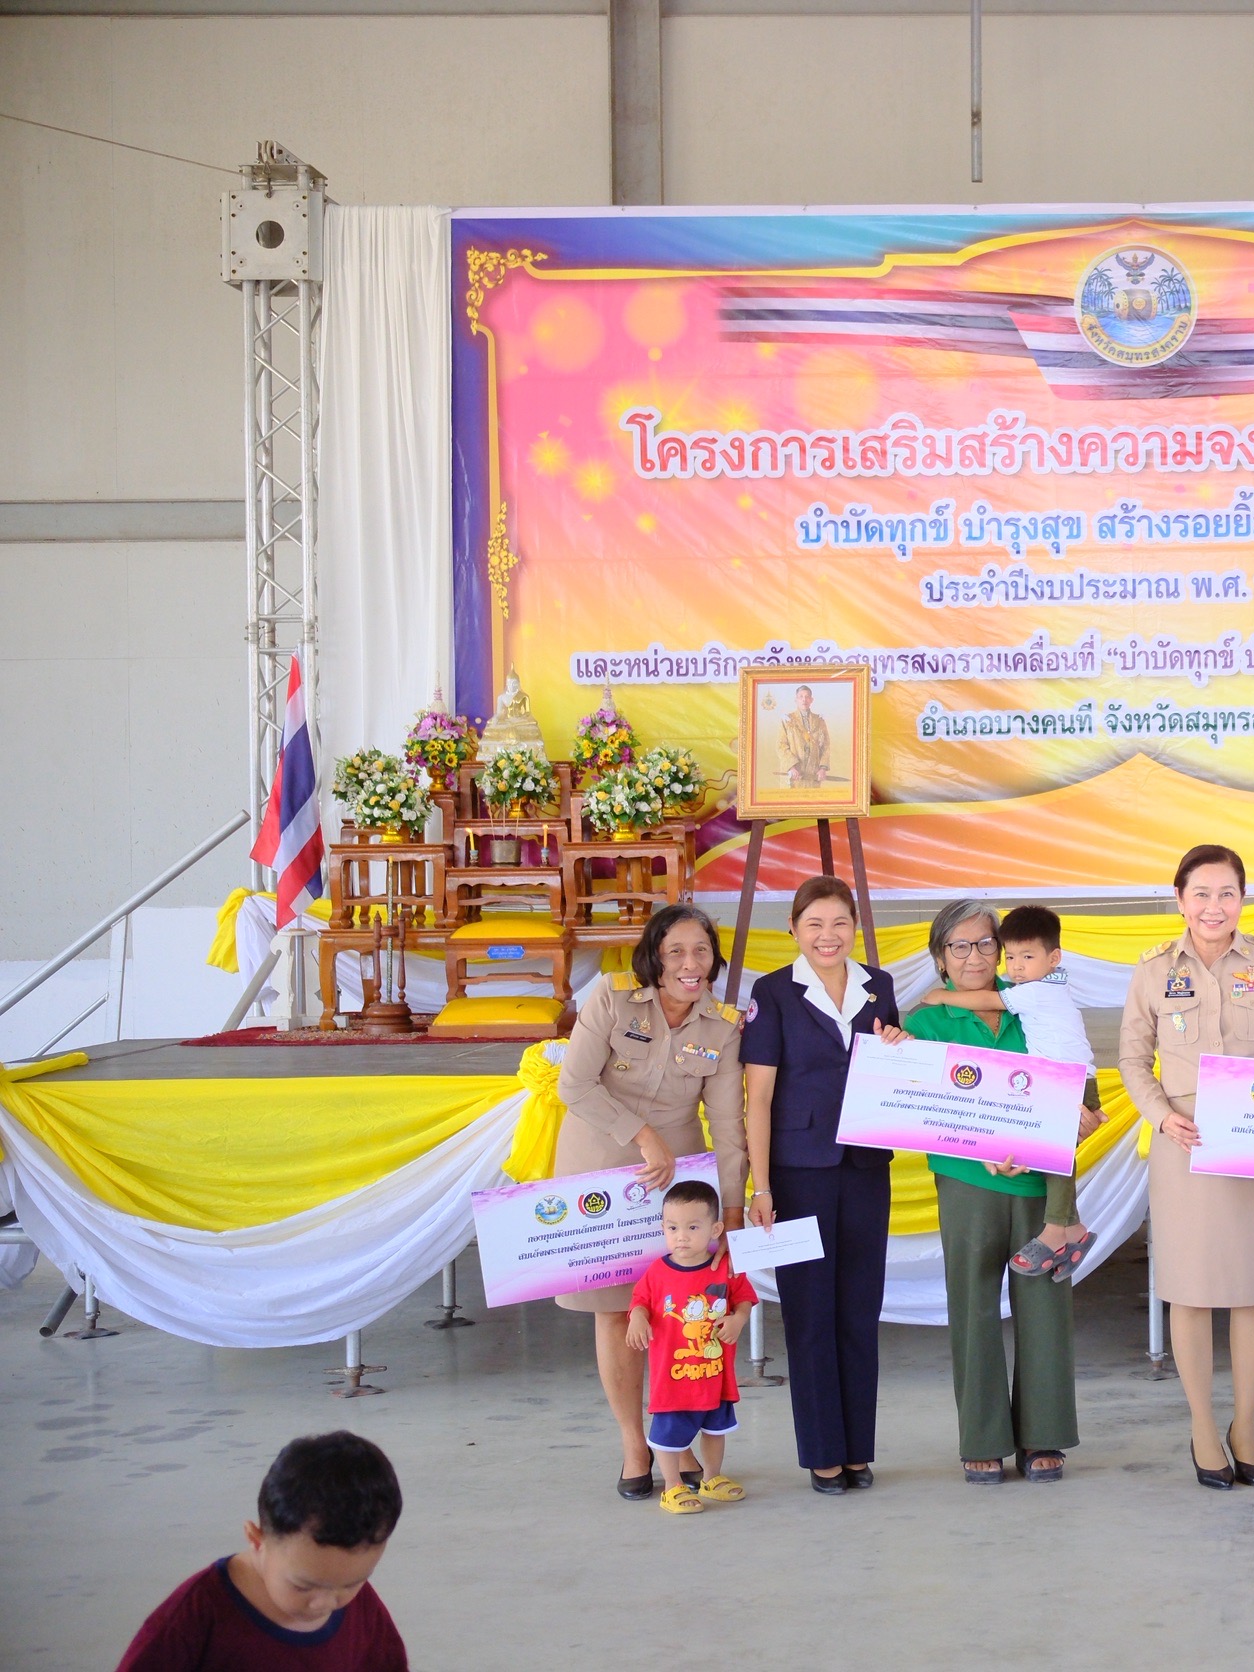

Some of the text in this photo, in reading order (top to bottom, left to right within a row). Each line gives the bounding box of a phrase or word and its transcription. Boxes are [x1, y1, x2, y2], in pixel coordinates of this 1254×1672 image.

[800, 504, 950, 556] บำบัดทุกข์
[963, 504, 1081, 555] บำรุงสุข
[925, 569, 1180, 603] ประจำปีงบประมาณ
[1191, 573, 1247, 598] พ.ศ.
[1107, 637, 1234, 681] “บำบัดทุกข์
[922, 704, 1093, 736] อำเภอบางคนที
[936, 1134, 977, 1147] 1,000 บาท
[583, 1266, 633, 1284] 1,000 บาท
